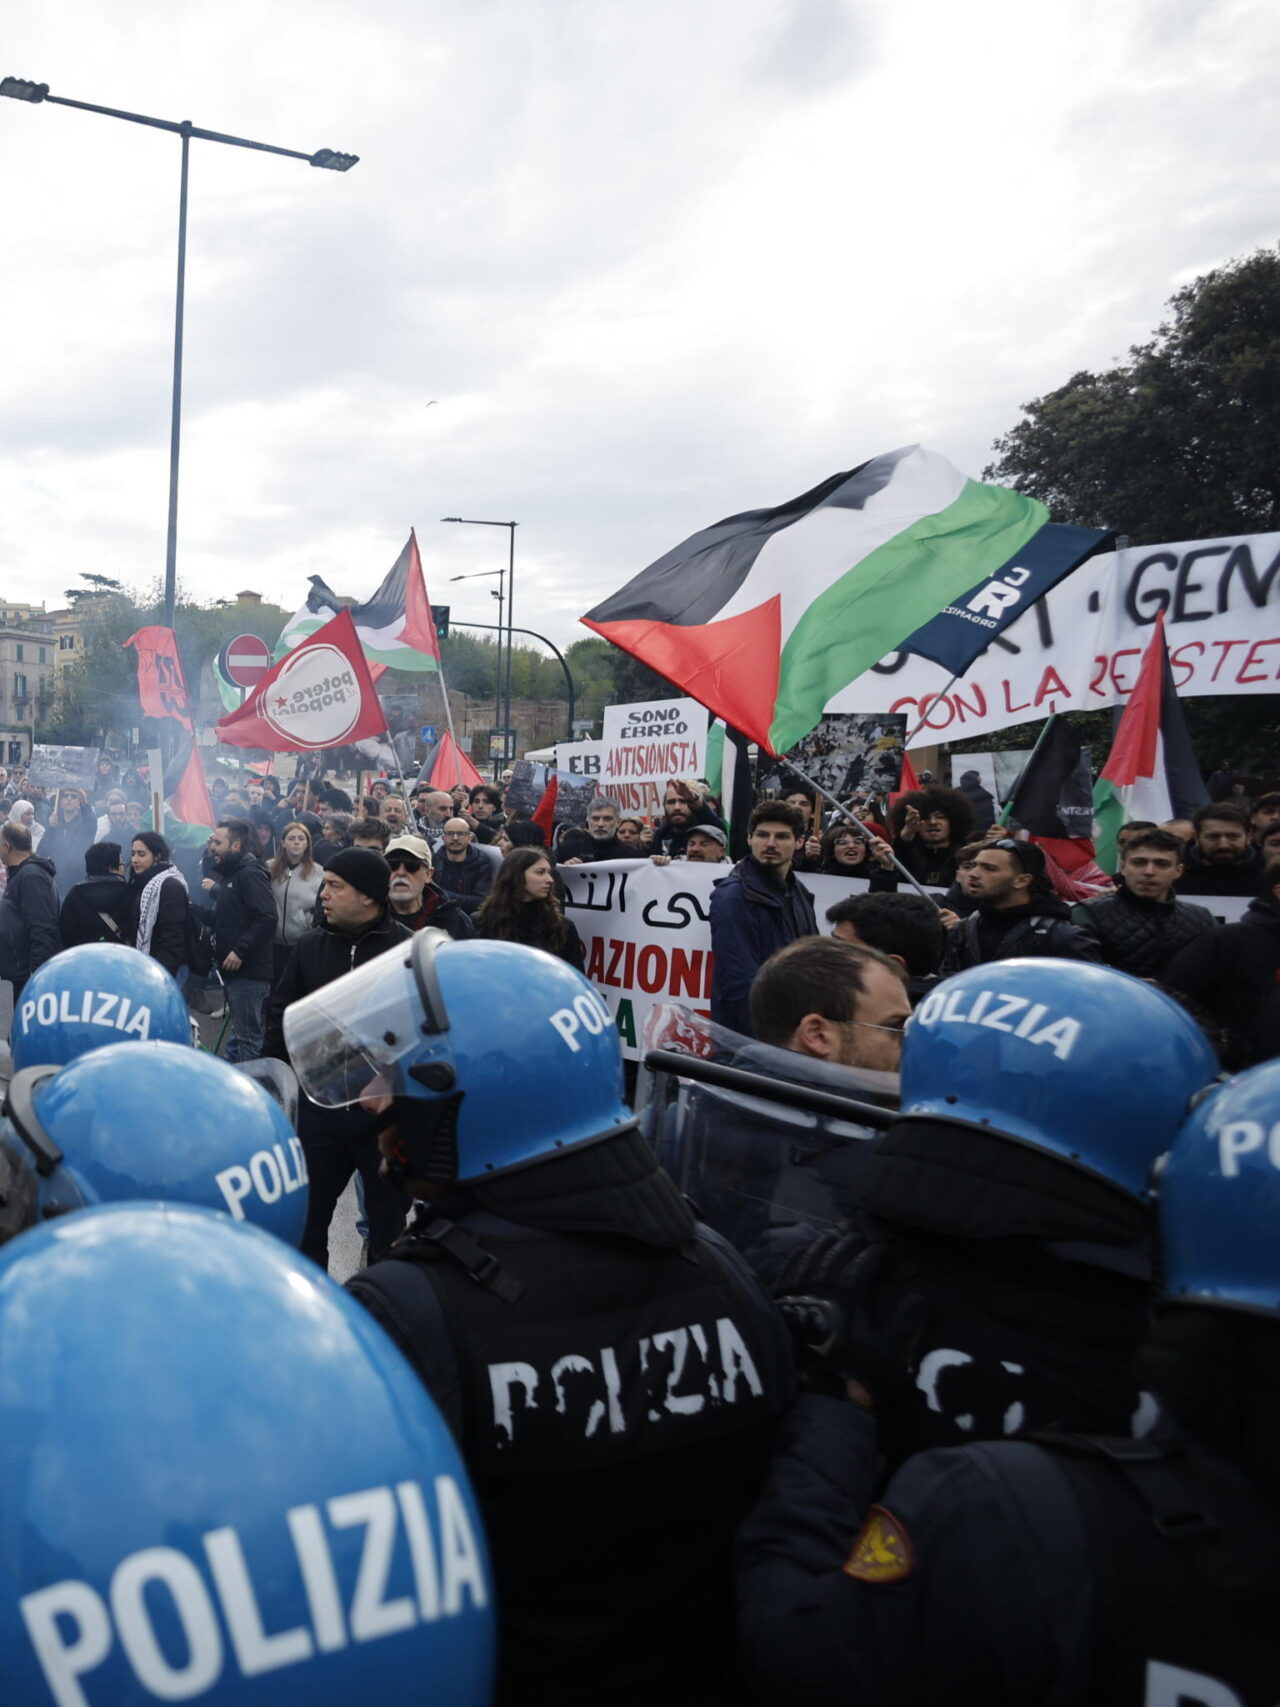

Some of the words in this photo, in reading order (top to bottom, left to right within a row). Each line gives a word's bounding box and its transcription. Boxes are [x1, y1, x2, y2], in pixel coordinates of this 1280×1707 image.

[1124, 543, 1280, 626] GEN
[628, 707, 680, 725] SONO
[888, 682, 987, 736] CON
[1003, 665, 1072, 714] LA
[620, 721, 688, 739] EBREO
[568, 754, 601, 775] EB
[605, 741, 698, 778] ANTISIONISTA
[21, 990, 152, 1040] POLIZIA
[20, 1474, 488, 1707] POLIZIA
